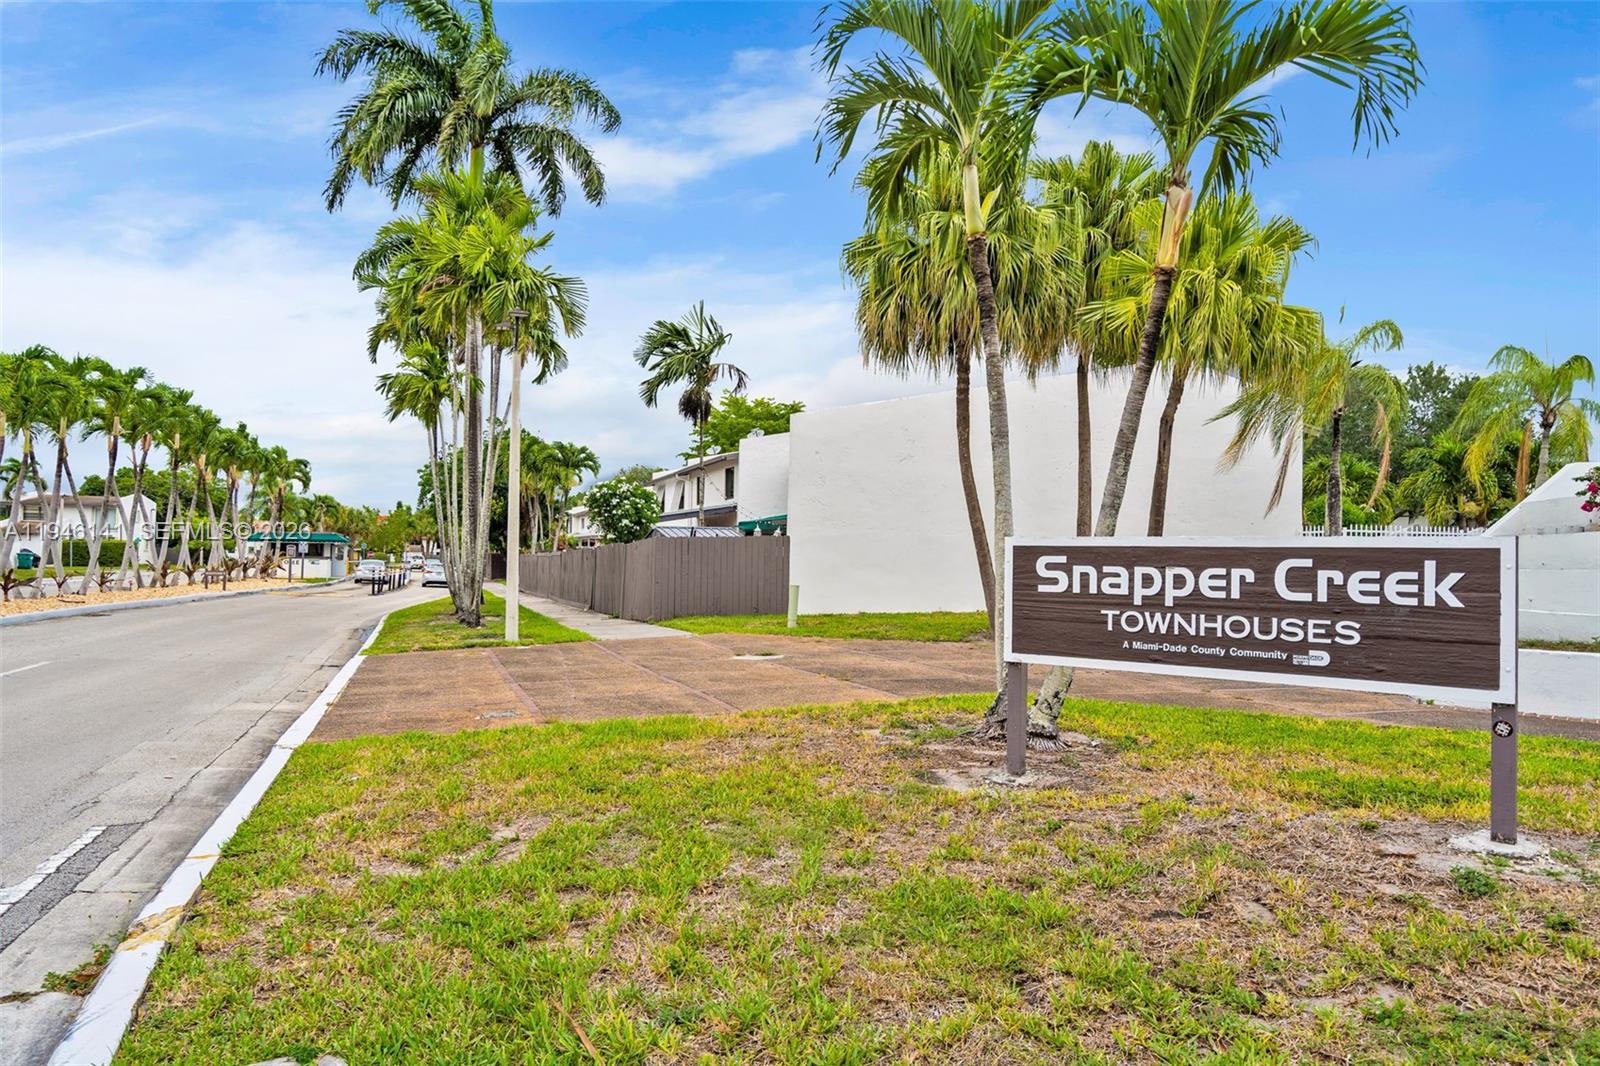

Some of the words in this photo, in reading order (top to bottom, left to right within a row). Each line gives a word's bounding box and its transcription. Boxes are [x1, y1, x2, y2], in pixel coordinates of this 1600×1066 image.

[1036, 555, 1255, 607] Snapper
[1275, 558, 1466, 608] Creek
[1101, 609, 1361, 645] TOWNHOUSES
[1122, 640, 1130, 649] A
[1132, 641, 1188, 653] Miami-Dade
[1190, 644, 1226, 657] County
[1229, 647, 1289, 661] Community
